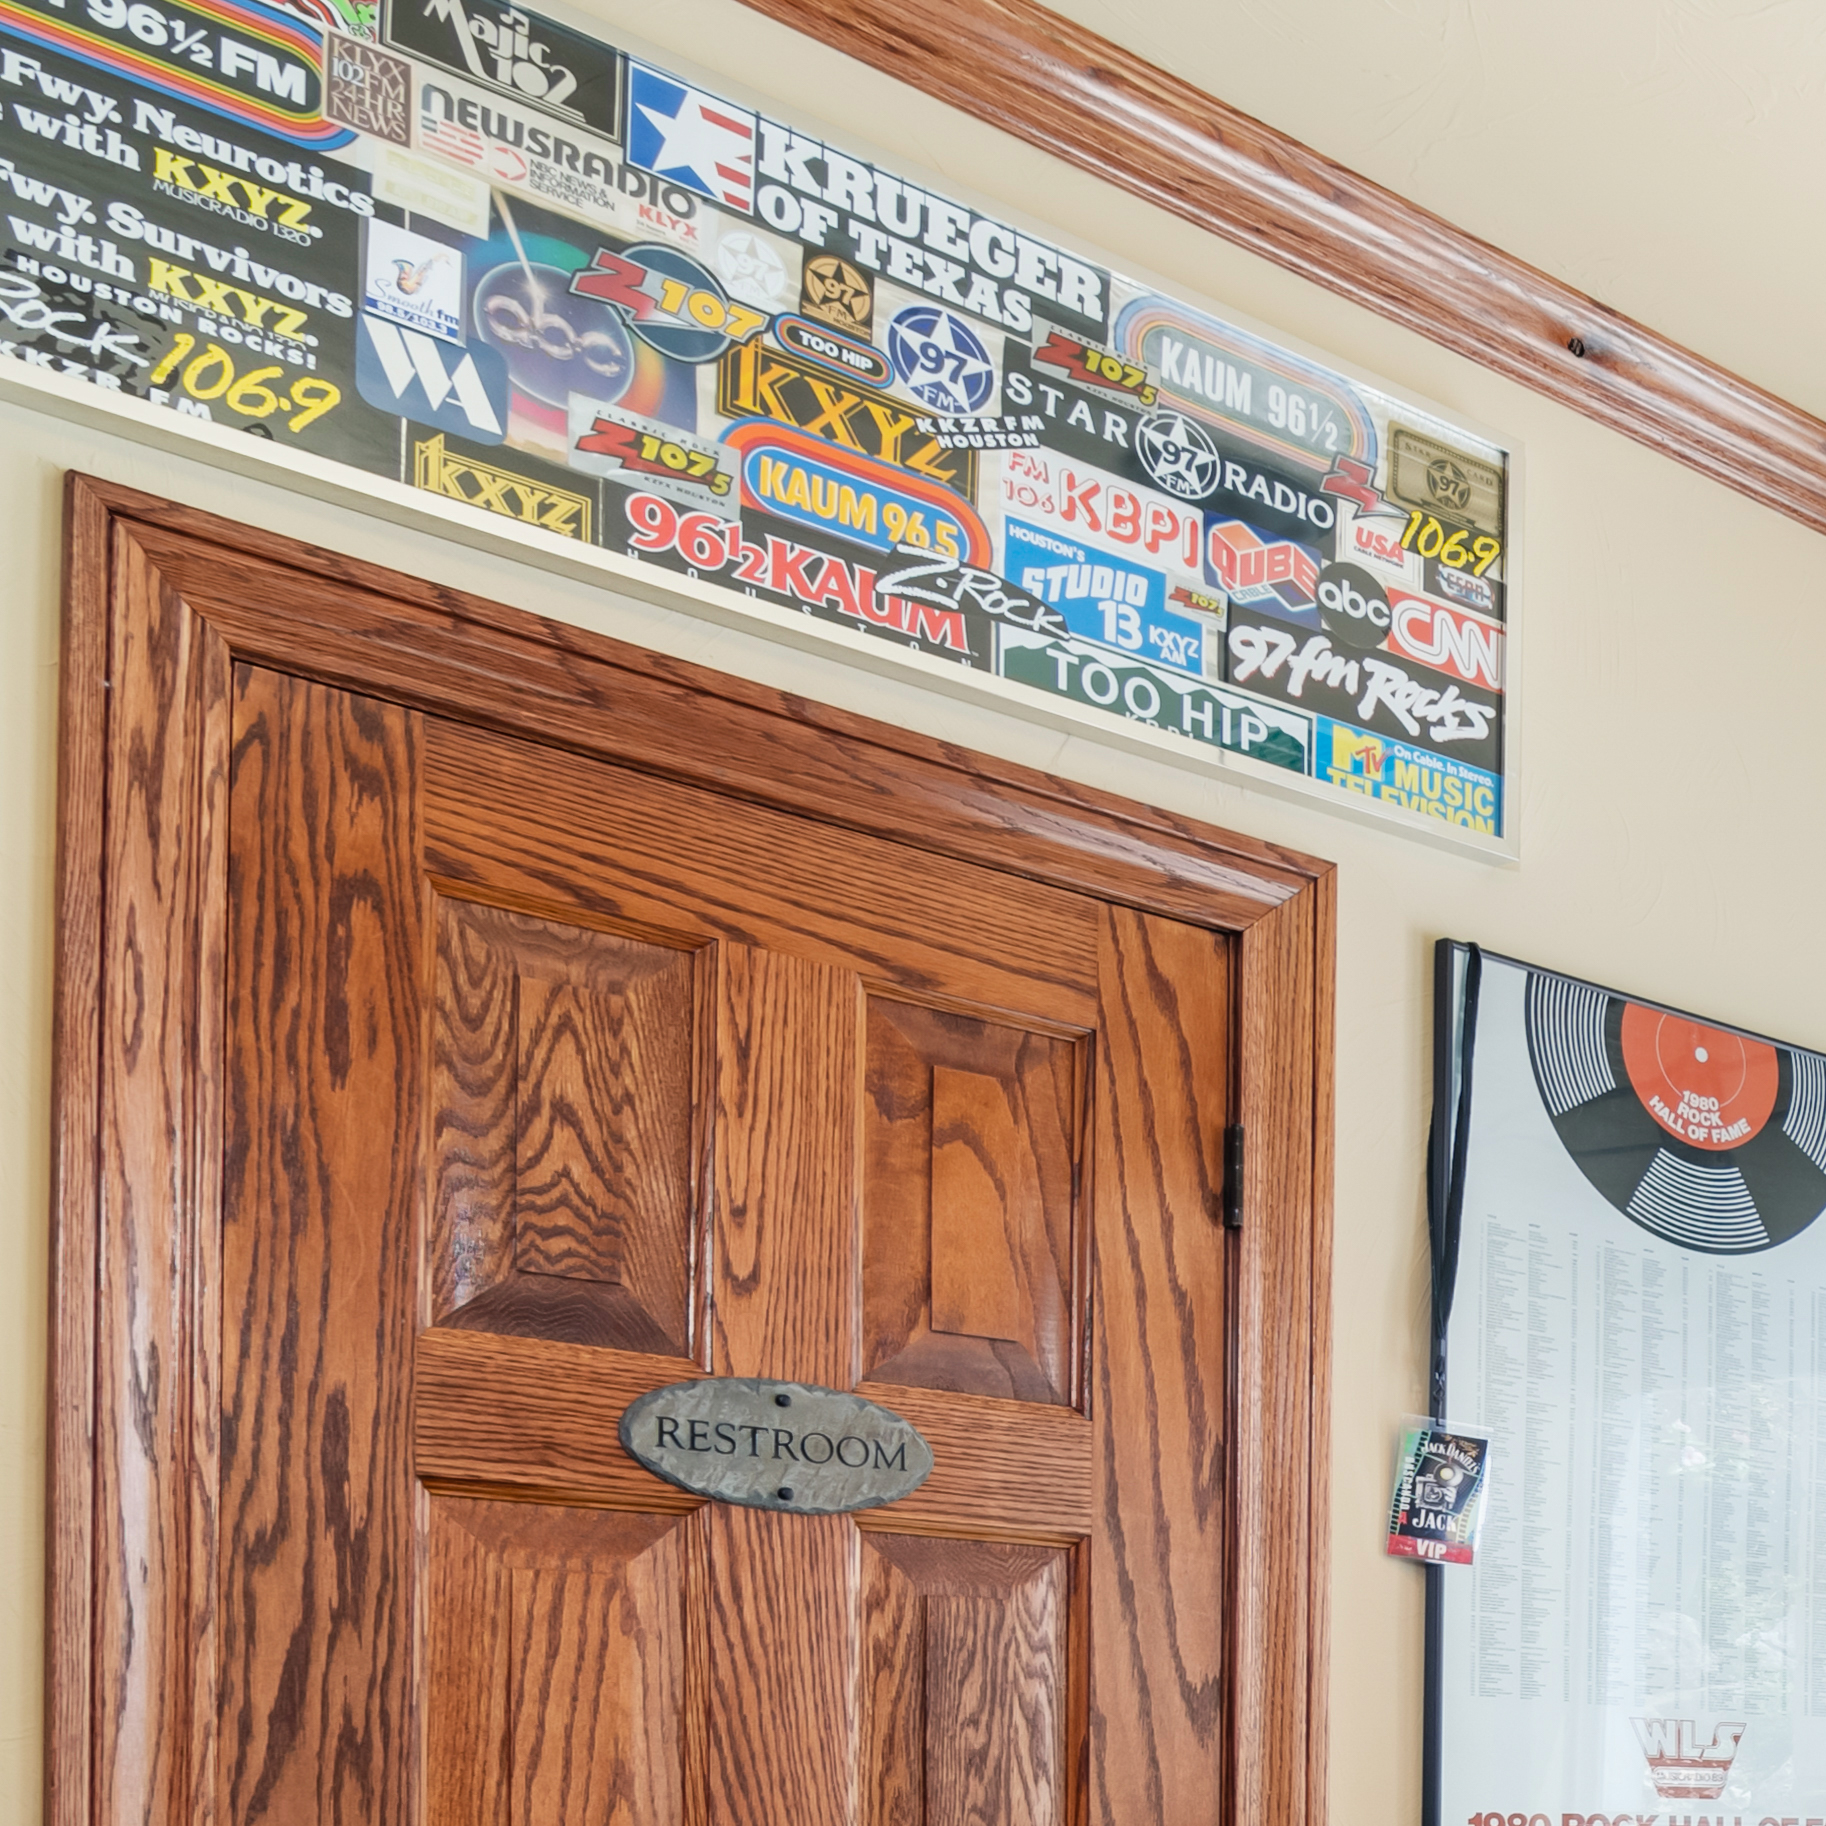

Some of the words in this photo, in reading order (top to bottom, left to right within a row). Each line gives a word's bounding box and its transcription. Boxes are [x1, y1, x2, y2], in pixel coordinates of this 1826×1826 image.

[220, 36, 307, 106] FM
[331, 37, 405, 83] KLYX
[490, 47, 578, 105] 102
[0, 48, 123, 124] Fwy.
[133, 98, 376, 217] Neurotics
[13, 103, 141, 172] with
[331, 101, 407, 142] NEWS
[529, 159, 560, 177] NBC
[559, 169, 601, 195] NEWS
[529, 168, 616, 212] INFORMATION
[529, 179, 584, 210] SERVICE
[153, 179, 268, 232] MUSICRADIO
[272, 222, 313, 248] 1320
[638, 203, 699, 241] KLYX
[757, 117, 1105, 323] KRUEGER
[7, 214, 137, 283] with
[105, 201, 354, 318] Survivors
[757, 184, 839, 247] OF
[847, 222, 1033, 334] TEXAS
[16, 255, 184, 325] HOUSTON
[197, 316, 318, 371] ROCKS!
[823, 277, 856, 305] 97
[826, 305, 848, 321] FM
[798, 328, 838, 358] TOO
[841, 347, 874, 372] HIP
[918, 341, 969, 385] 97
[1161, 335, 1253, 417] KAUM
[734, 334, 958, 484] KXYZ
[914, 416, 1001, 434] KKZR
[1003, 415, 1047, 432] FM
[935, 432, 1041, 450] HOUSTON
[1003, 371, 1131, 449] STAR
[1161, 439, 1200, 474] 97
[1223, 460, 1336, 530] RADIO
[420, 433, 582, 538] KXYZ
[1008, 449, 1051, 485] FM
[1439, 475, 1461, 497] 97
[758, 454, 878, 535] KAUM
[1003, 476, 1056, 515] 106
[1058, 467, 1200, 569] KBPI
[1008, 523, 1086, 564] HOUSTON'S
[1354, 525, 1406, 564] USA
[1021, 563, 1149, 608] STUDIO
[1231, 583, 1272, 602] CABLE
[1317, 578, 1392, 628] abc
[1098, 599, 1144, 651] 13
[1148, 623, 1201, 660] KXYZ
[1392, 599, 1502, 690] CNN
[1160, 647, 1189, 667] AM
[1228, 624, 1297, 683] 97
[1045, 646, 1162, 720] TOO
[1181, 693, 1270, 752] HIP
[1332, 724, 1393, 781] MTV
[1394, 745, 1413, 761] On
[1446, 761, 1458, 776] In
[1394, 759, 1495, 817] MUSIC
[1648, 1094, 1686, 1135] HALL
[1687, 1126, 1709, 1142] OF
[1710, 1117, 1752, 1144] FAME
[1676, 1101, 1724, 1128] ROCK
[1681, 1089, 1720, 1112] 1980
[654, 1415, 908, 1473] RESTROOM
[1411, 1508, 1458, 1533] JACK
[1416, 1538, 1448, 1560] VIP
[1628, 1716, 1748, 1760] WLS
